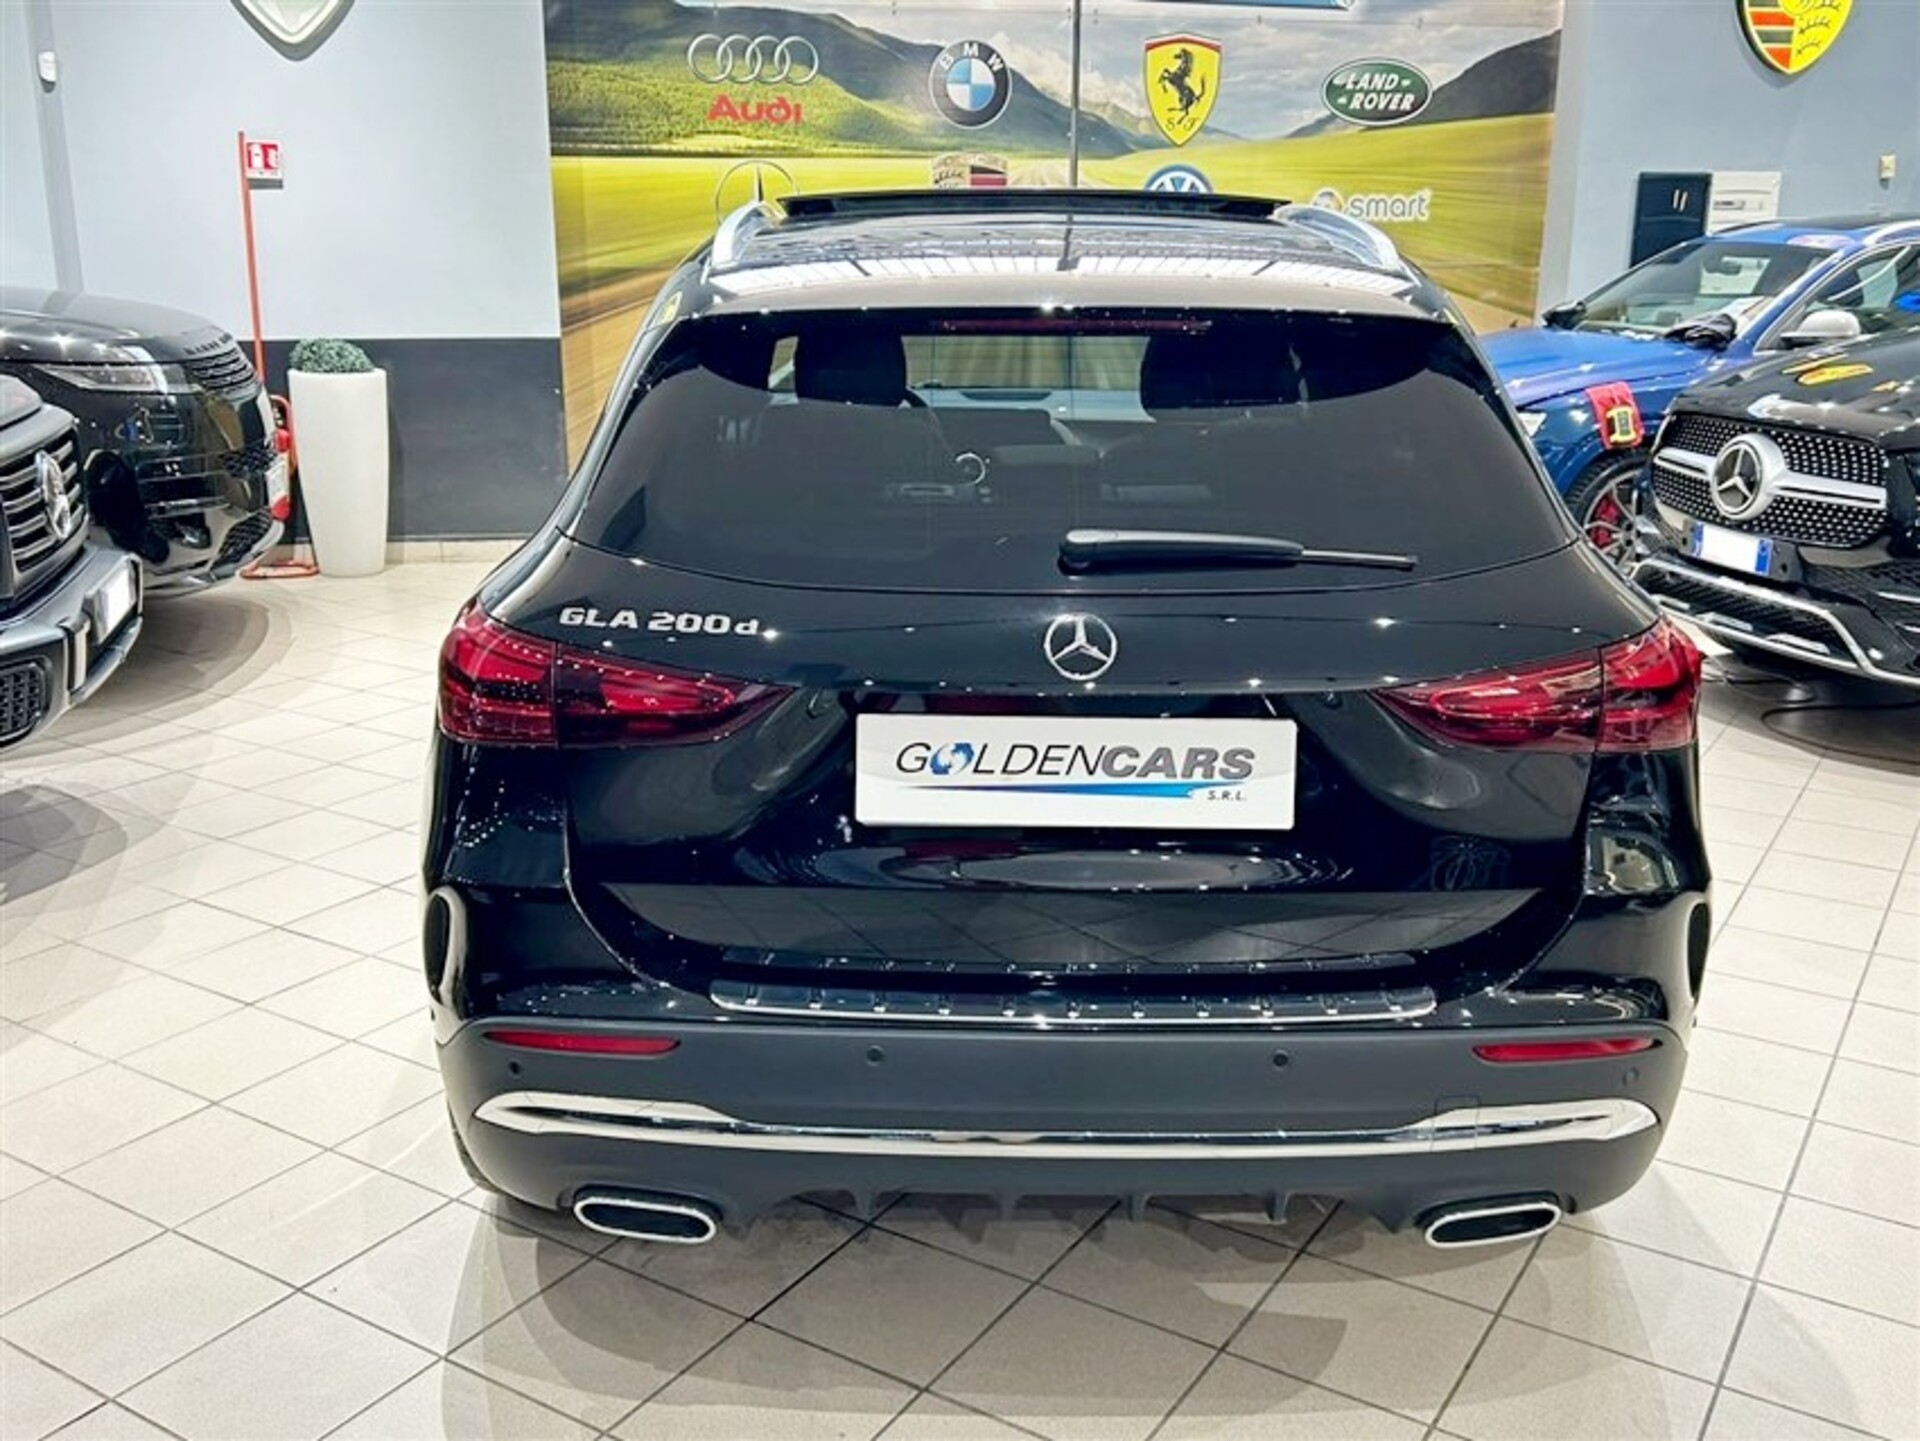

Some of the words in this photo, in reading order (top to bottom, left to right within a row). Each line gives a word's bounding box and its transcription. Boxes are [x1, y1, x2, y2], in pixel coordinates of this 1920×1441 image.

[939, 42, 1004, 72] BMW
[1345, 72, 1399, 91] LAND
[706, 93, 803, 125] Audi
[1349, 93, 1415, 110] ROVER
[1349, 193, 1427, 218] smart
[559, 607, 639, 629] GLA
[896, 742, 1256, 779] GOLDENCARS
